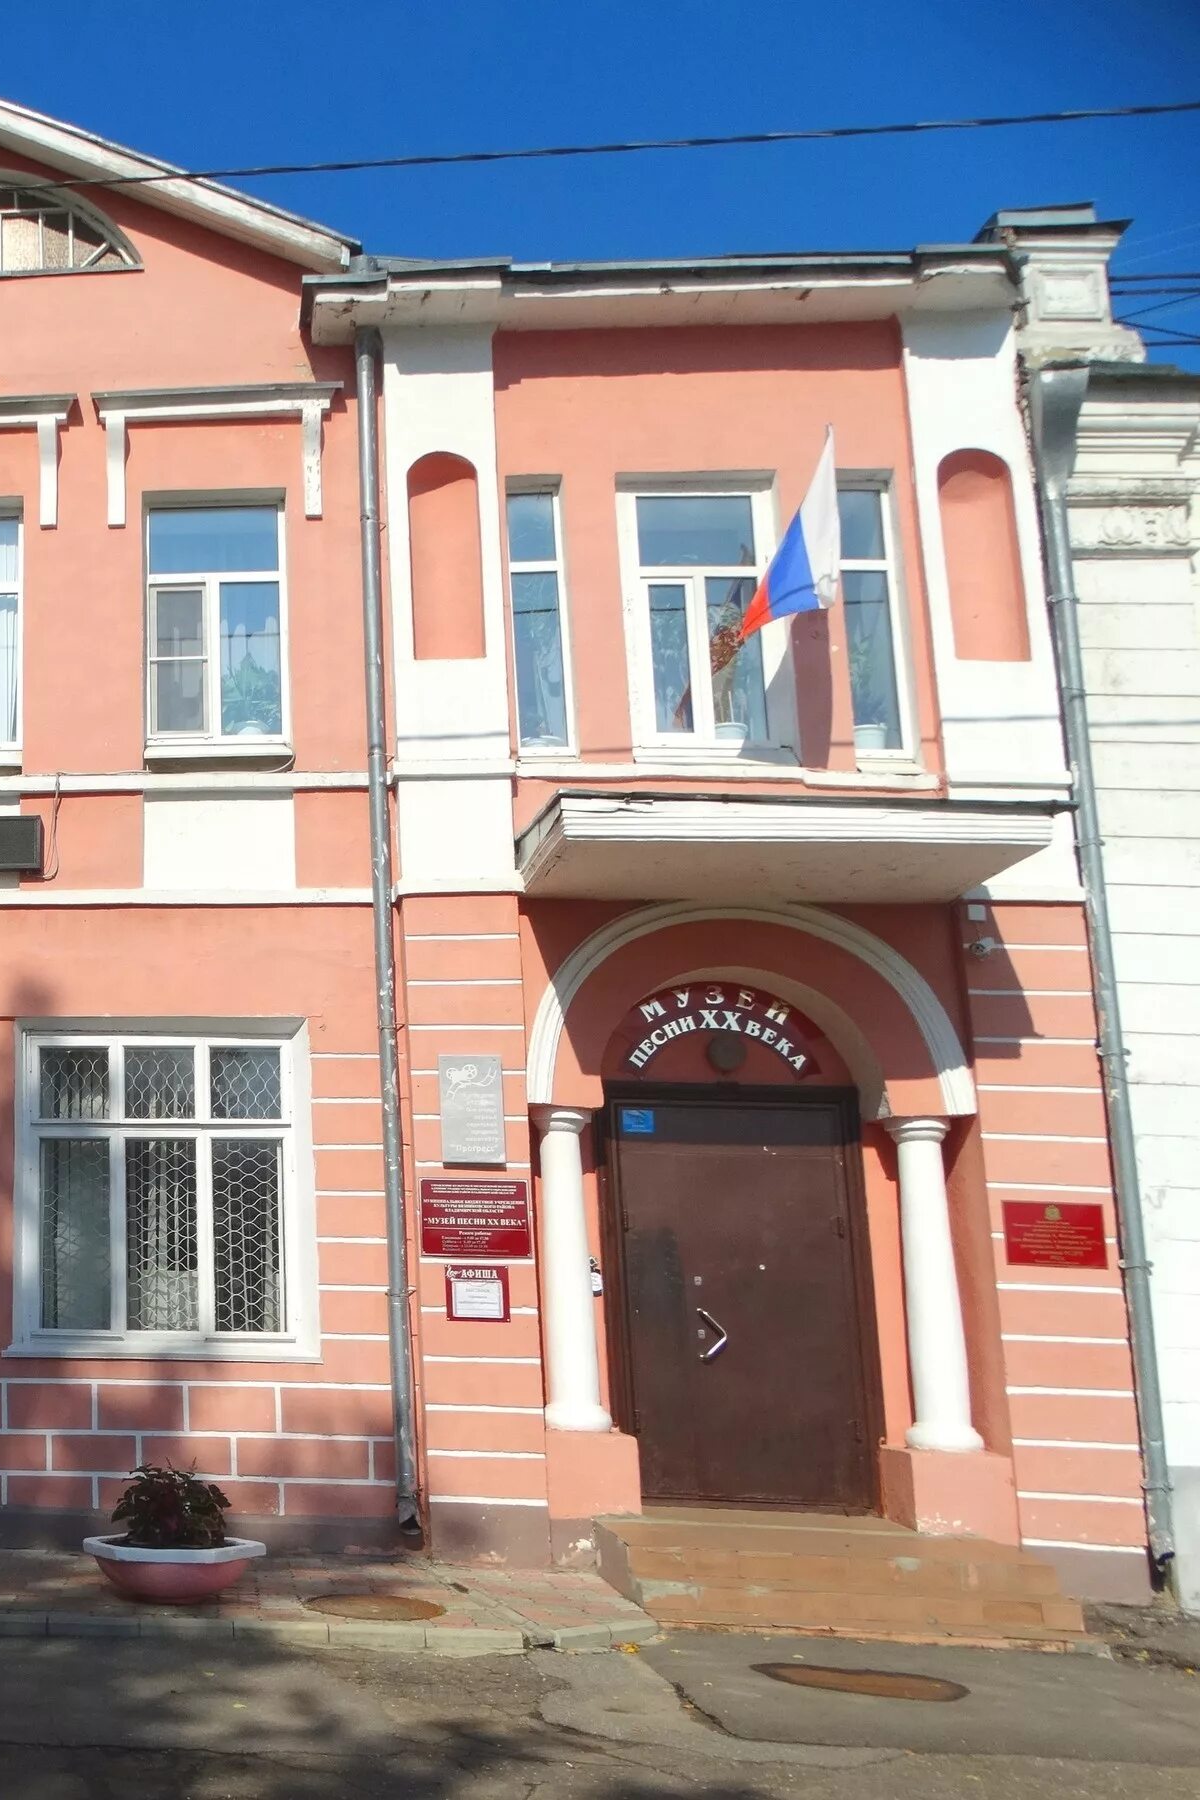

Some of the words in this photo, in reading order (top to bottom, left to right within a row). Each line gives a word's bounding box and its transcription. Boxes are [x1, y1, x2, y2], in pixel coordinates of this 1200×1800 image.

[638, 985, 790, 1026] МУЗЕЙ
[628, 1015, 697, 1069] ПЕСНИ
[743, 1020, 807, 1071] ВЕКА
[424, 1216, 456, 1225] "МУЗЕЙ
[457, 1217, 486, 1225] ПЕСНИ
[500, 1218, 527, 1226] ВЕКА"
[461, 1269, 498, 1279] АФИША
